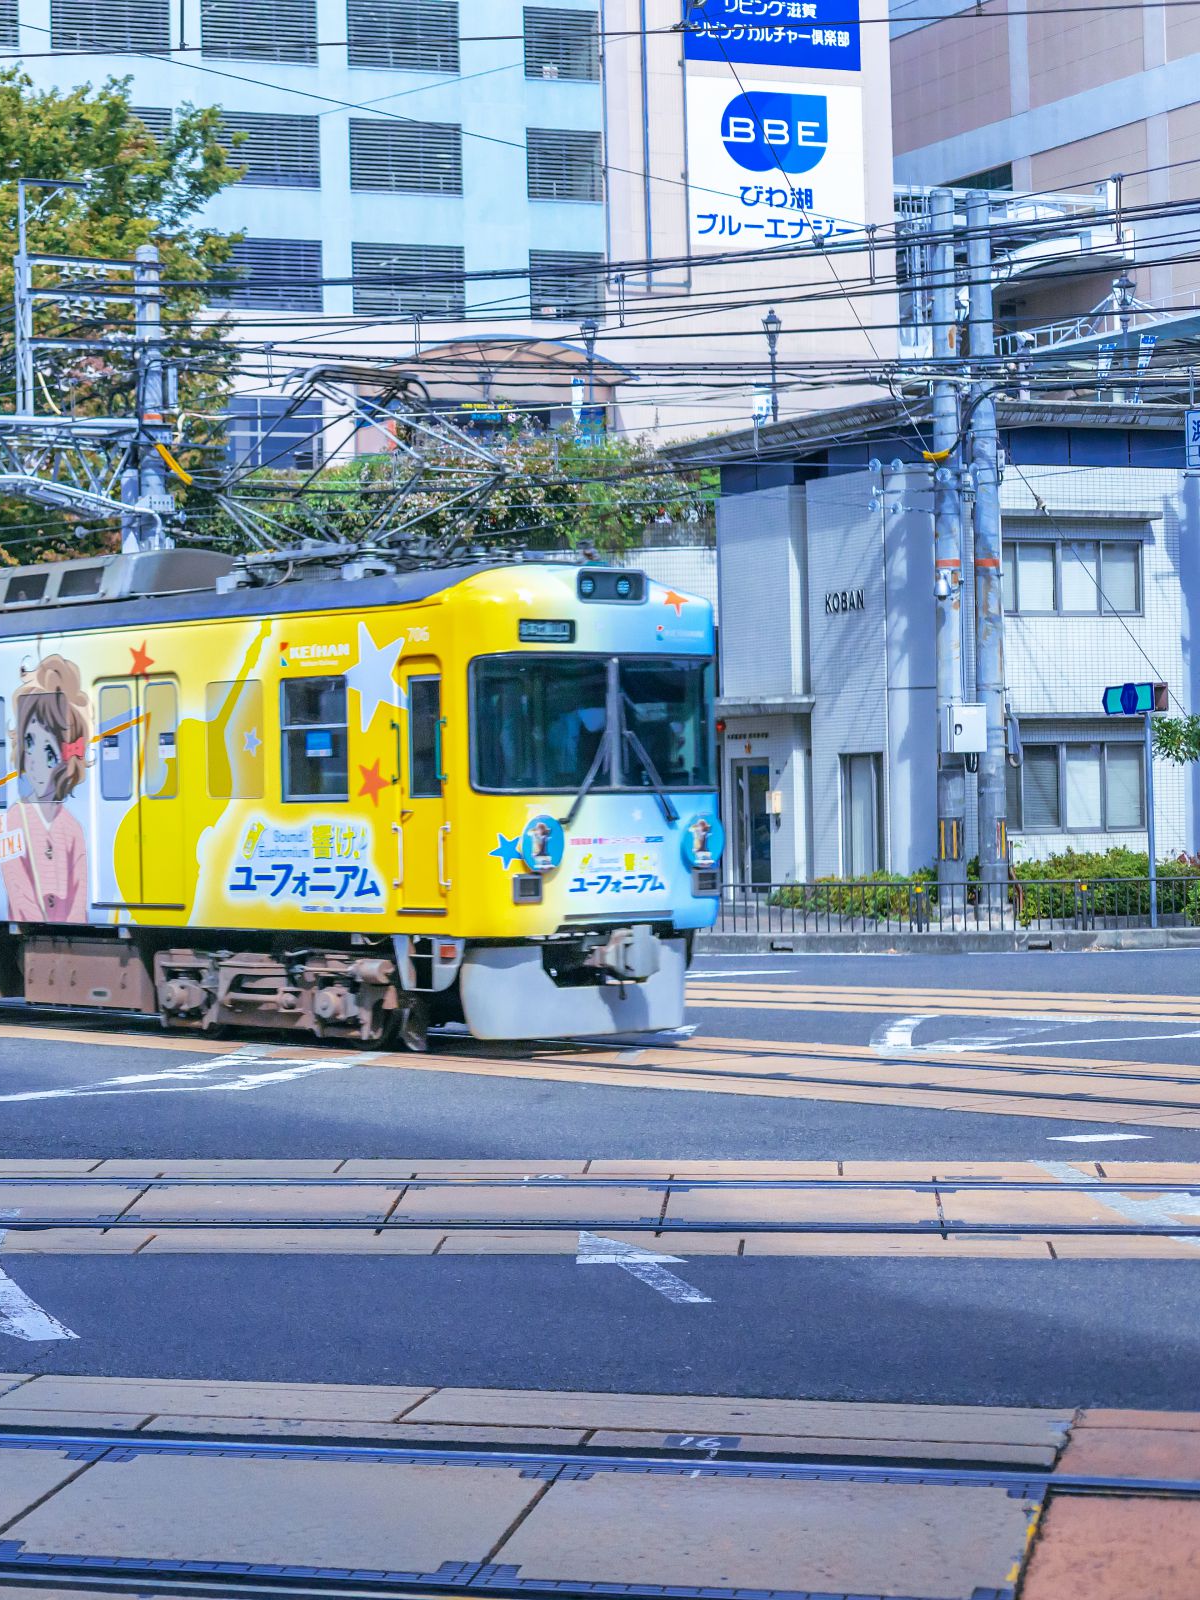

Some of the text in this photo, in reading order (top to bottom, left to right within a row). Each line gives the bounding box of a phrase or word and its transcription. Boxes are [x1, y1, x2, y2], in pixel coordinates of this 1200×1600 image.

[724, 0, 816, 18] リビング滋賀
[722, 117, 827, 147] BBE
[740, 186, 813, 209] びわ湖
[697, 213, 857, 238] ブルーエナジー
[825, 590, 864, 614] KOBAN
[290, 643, 350, 659] KEIHAN
[229, 863, 381, 899] ユーフォニアム
[569, 874, 665, 894] ユーフォニアム
